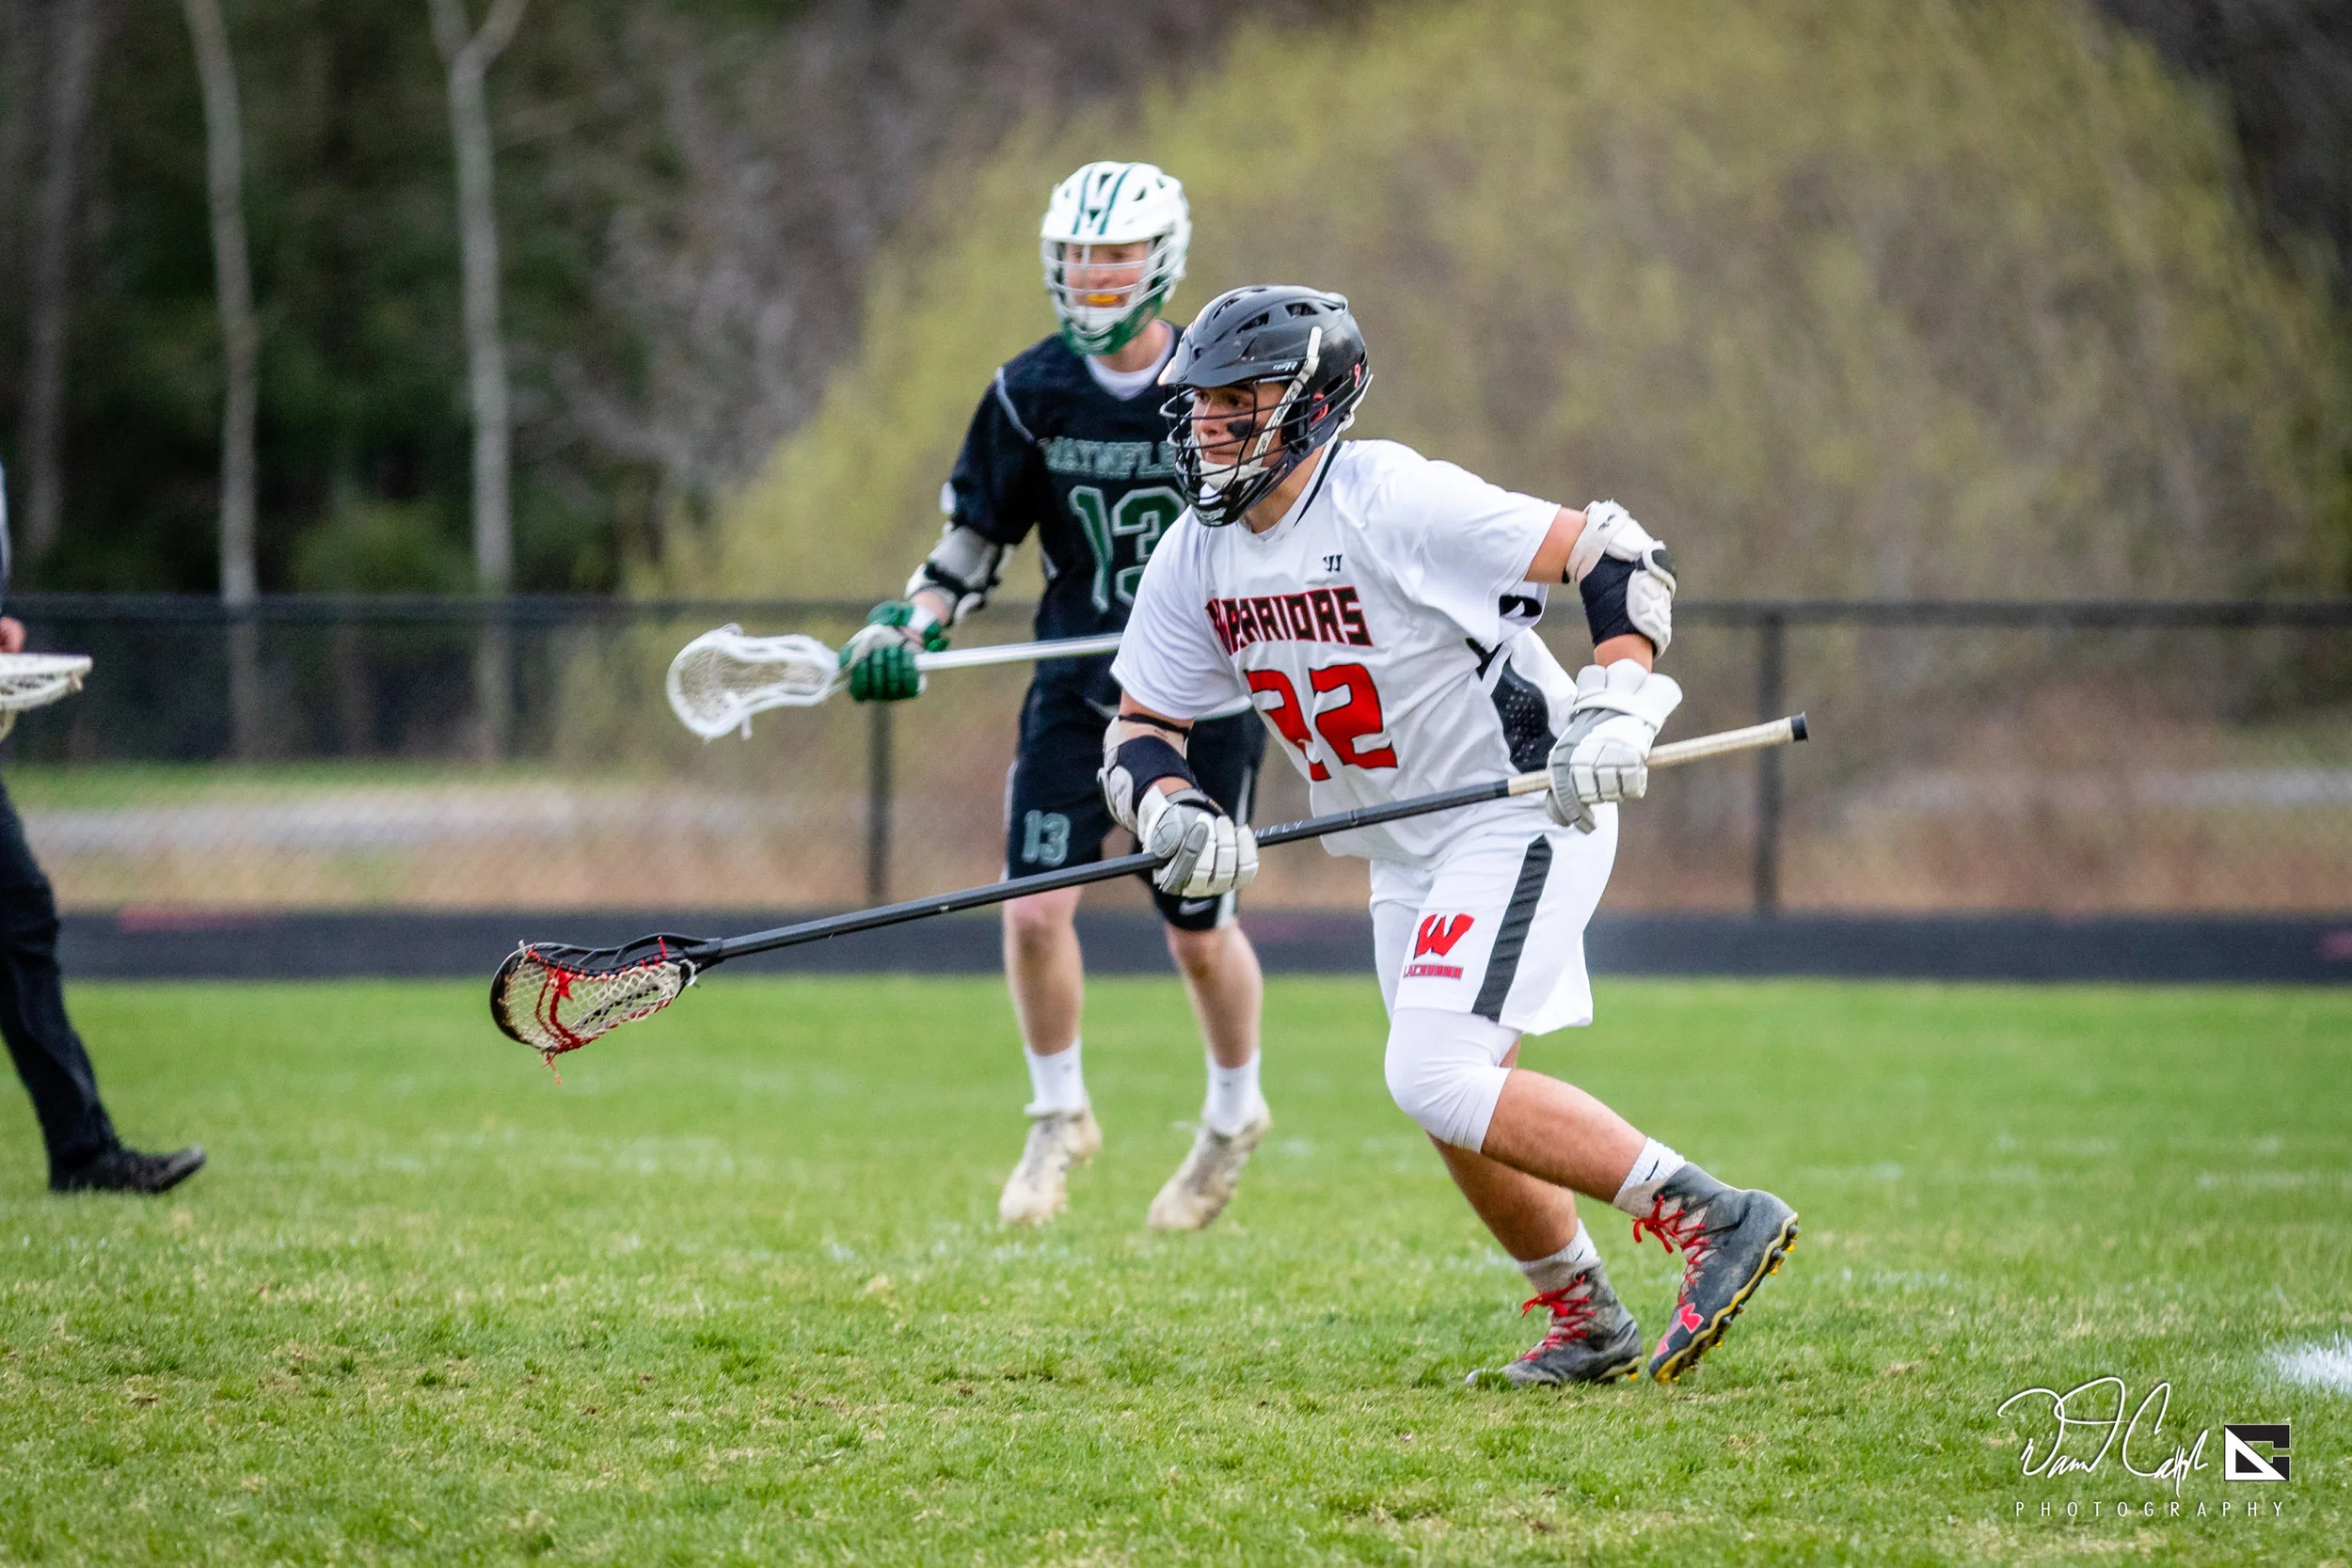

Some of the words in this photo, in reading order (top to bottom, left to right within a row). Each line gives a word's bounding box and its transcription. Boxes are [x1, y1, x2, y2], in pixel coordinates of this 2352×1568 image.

[1204, 586, 1374, 656] WARRIORS
[1243, 662, 1399, 782] 22
[1021, 809, 1071, 866] 13
